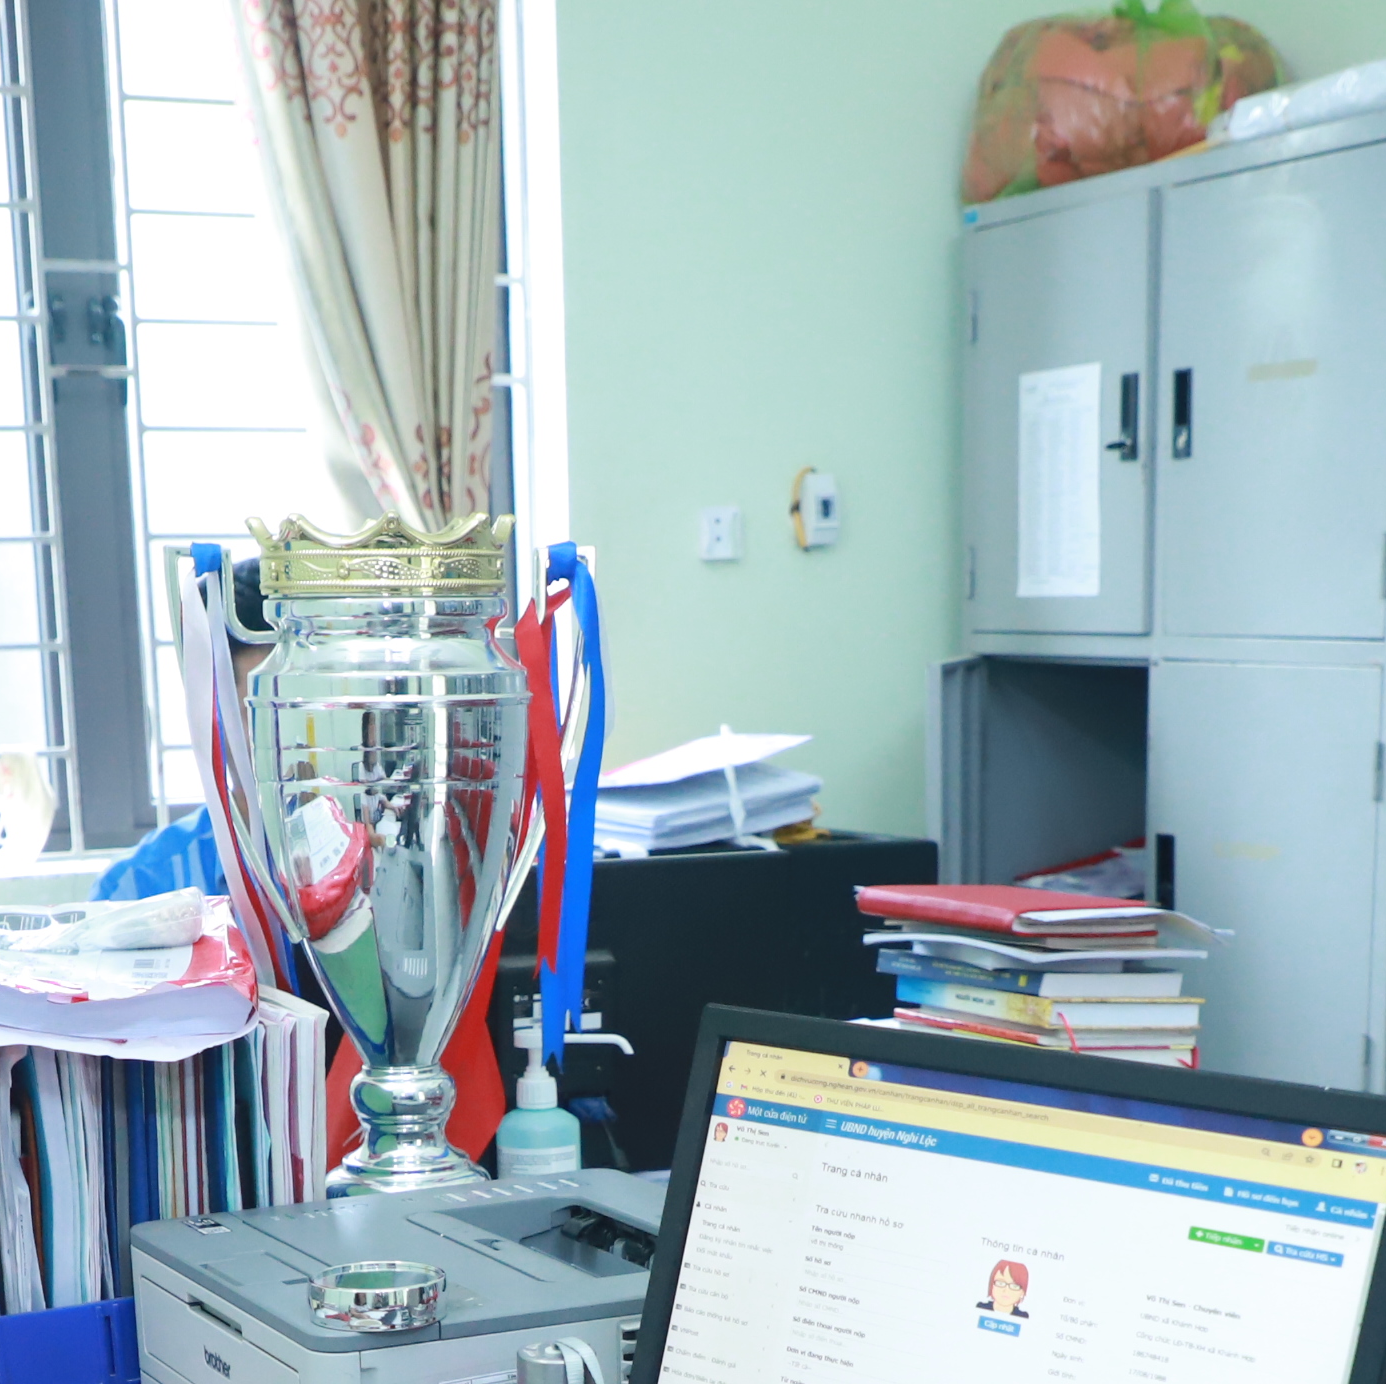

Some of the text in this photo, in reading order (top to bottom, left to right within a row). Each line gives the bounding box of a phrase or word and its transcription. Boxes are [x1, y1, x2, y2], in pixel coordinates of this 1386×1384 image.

[746, 1106, 808, 1124] Một cửa điện tử
[840, 1121, 938, 1147] UBND huyện Nghi Lộc
[820, 1162, 888, 1183] Trang cá nhân
[815, 1204, 904, 1229] Tra cứu nhanh hồ sơ
[979, 1236, 1065, 1261] Thông tin cá nhân
[203, 1345, 230, 1377] brother
